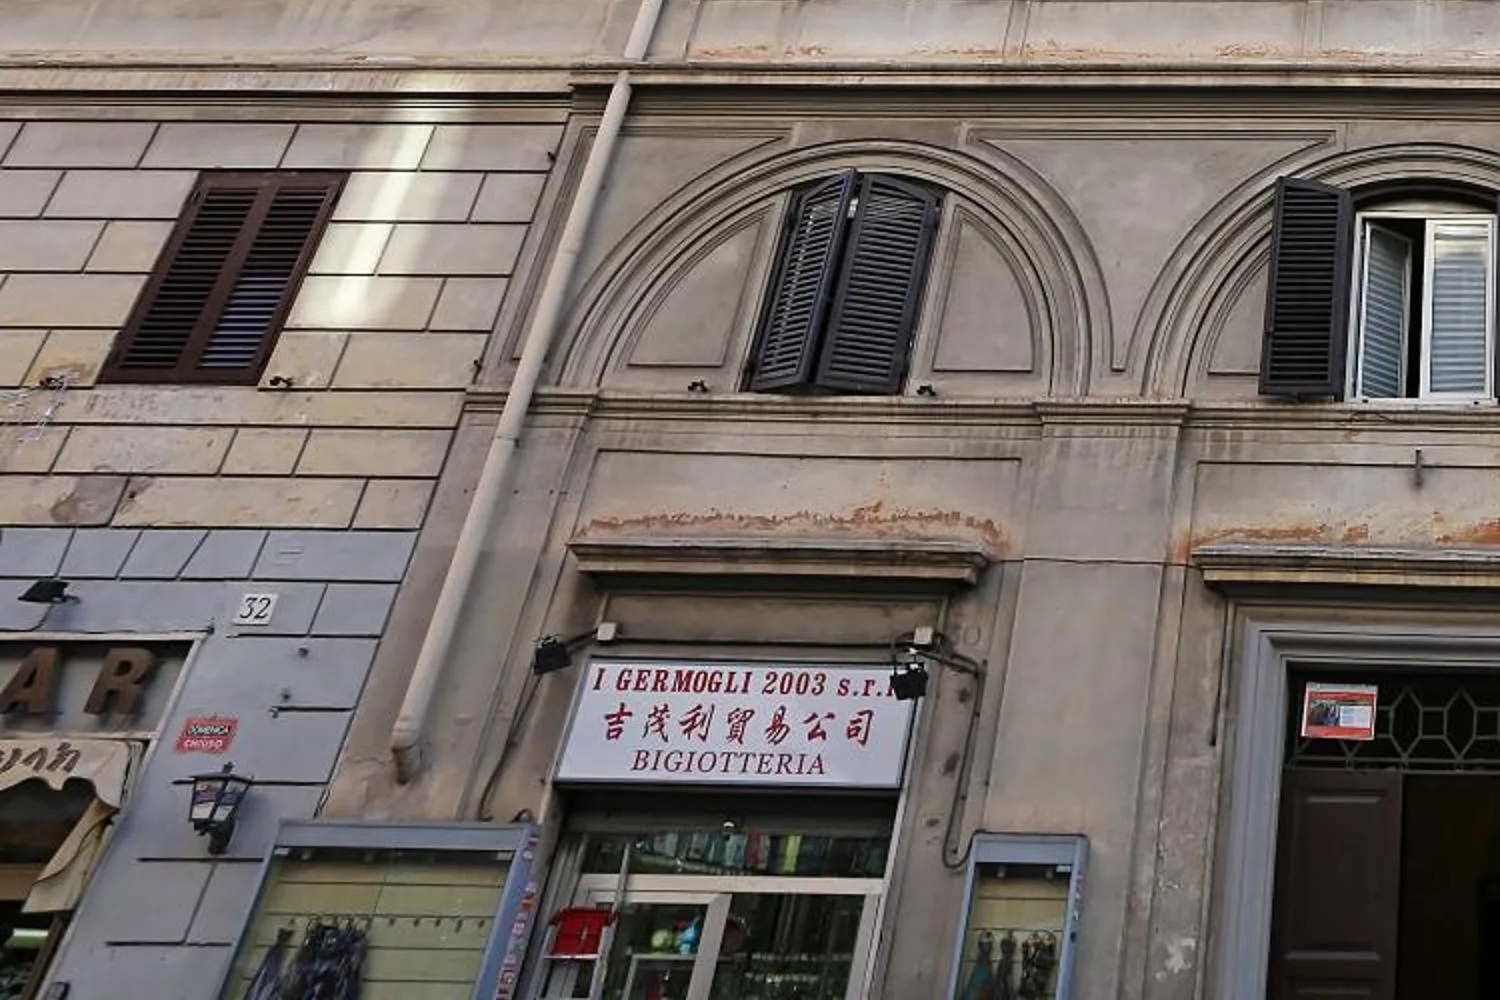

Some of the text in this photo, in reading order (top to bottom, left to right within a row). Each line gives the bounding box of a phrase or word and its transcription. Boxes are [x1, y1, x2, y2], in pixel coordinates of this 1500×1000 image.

[239, 597, 271, 619] 32
[593, 668, 606, 690] I
[616, 668, 752, 694] GERMOGLI
[762, 671, 827, 696] 2003
[604, 703, 874, 746] 吉茂利貿易公司
[632, 750, 825, 775] BIGIOTTERIA
